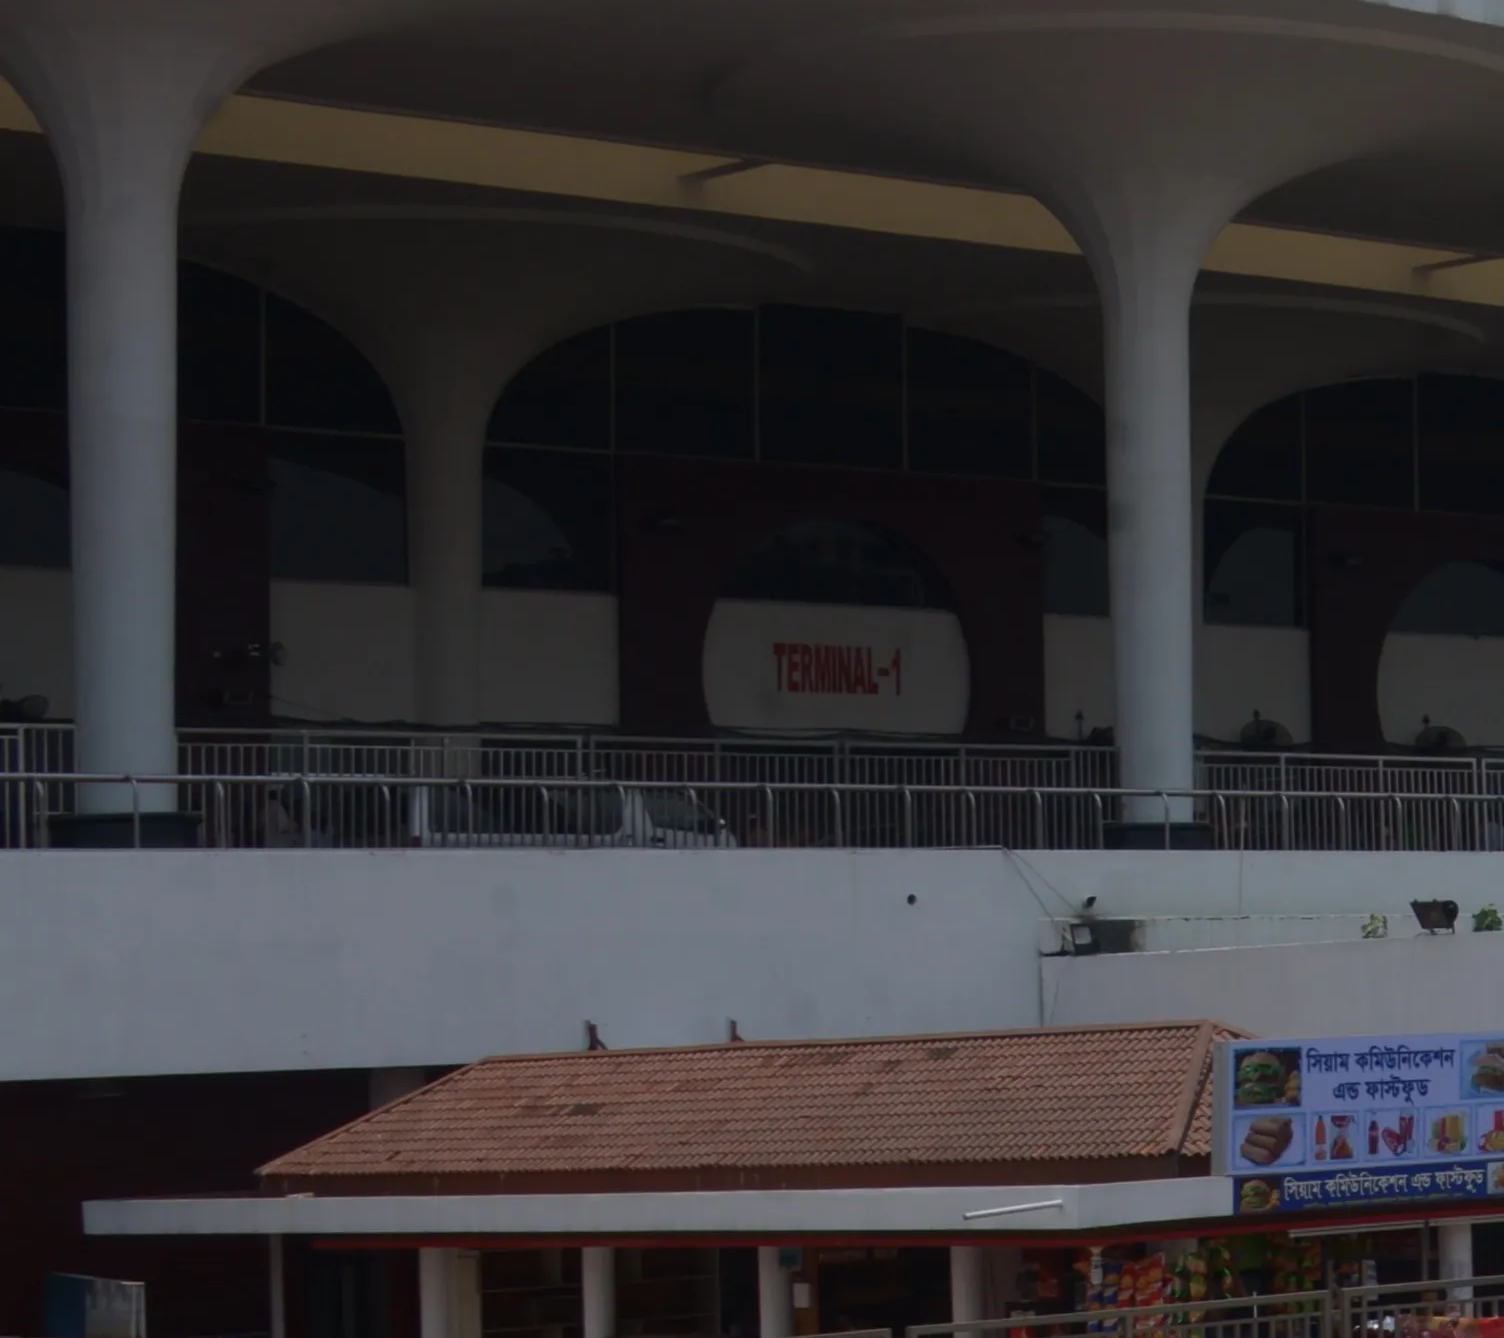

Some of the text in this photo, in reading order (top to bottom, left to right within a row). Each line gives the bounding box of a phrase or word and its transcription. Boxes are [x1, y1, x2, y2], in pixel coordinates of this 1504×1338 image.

[773, 642, 902, 697] TERMINAL-1
[1306, 1044, 1455, 1074] সিয়াম কমিউনিকেশন
[1365, 1075, 1431, 1105] ফাস্টফুড
[1283, 1176, 1321, 1202] সিয়াম
[1325, 1171, 1408, 1198] কমিউনিকেশন
